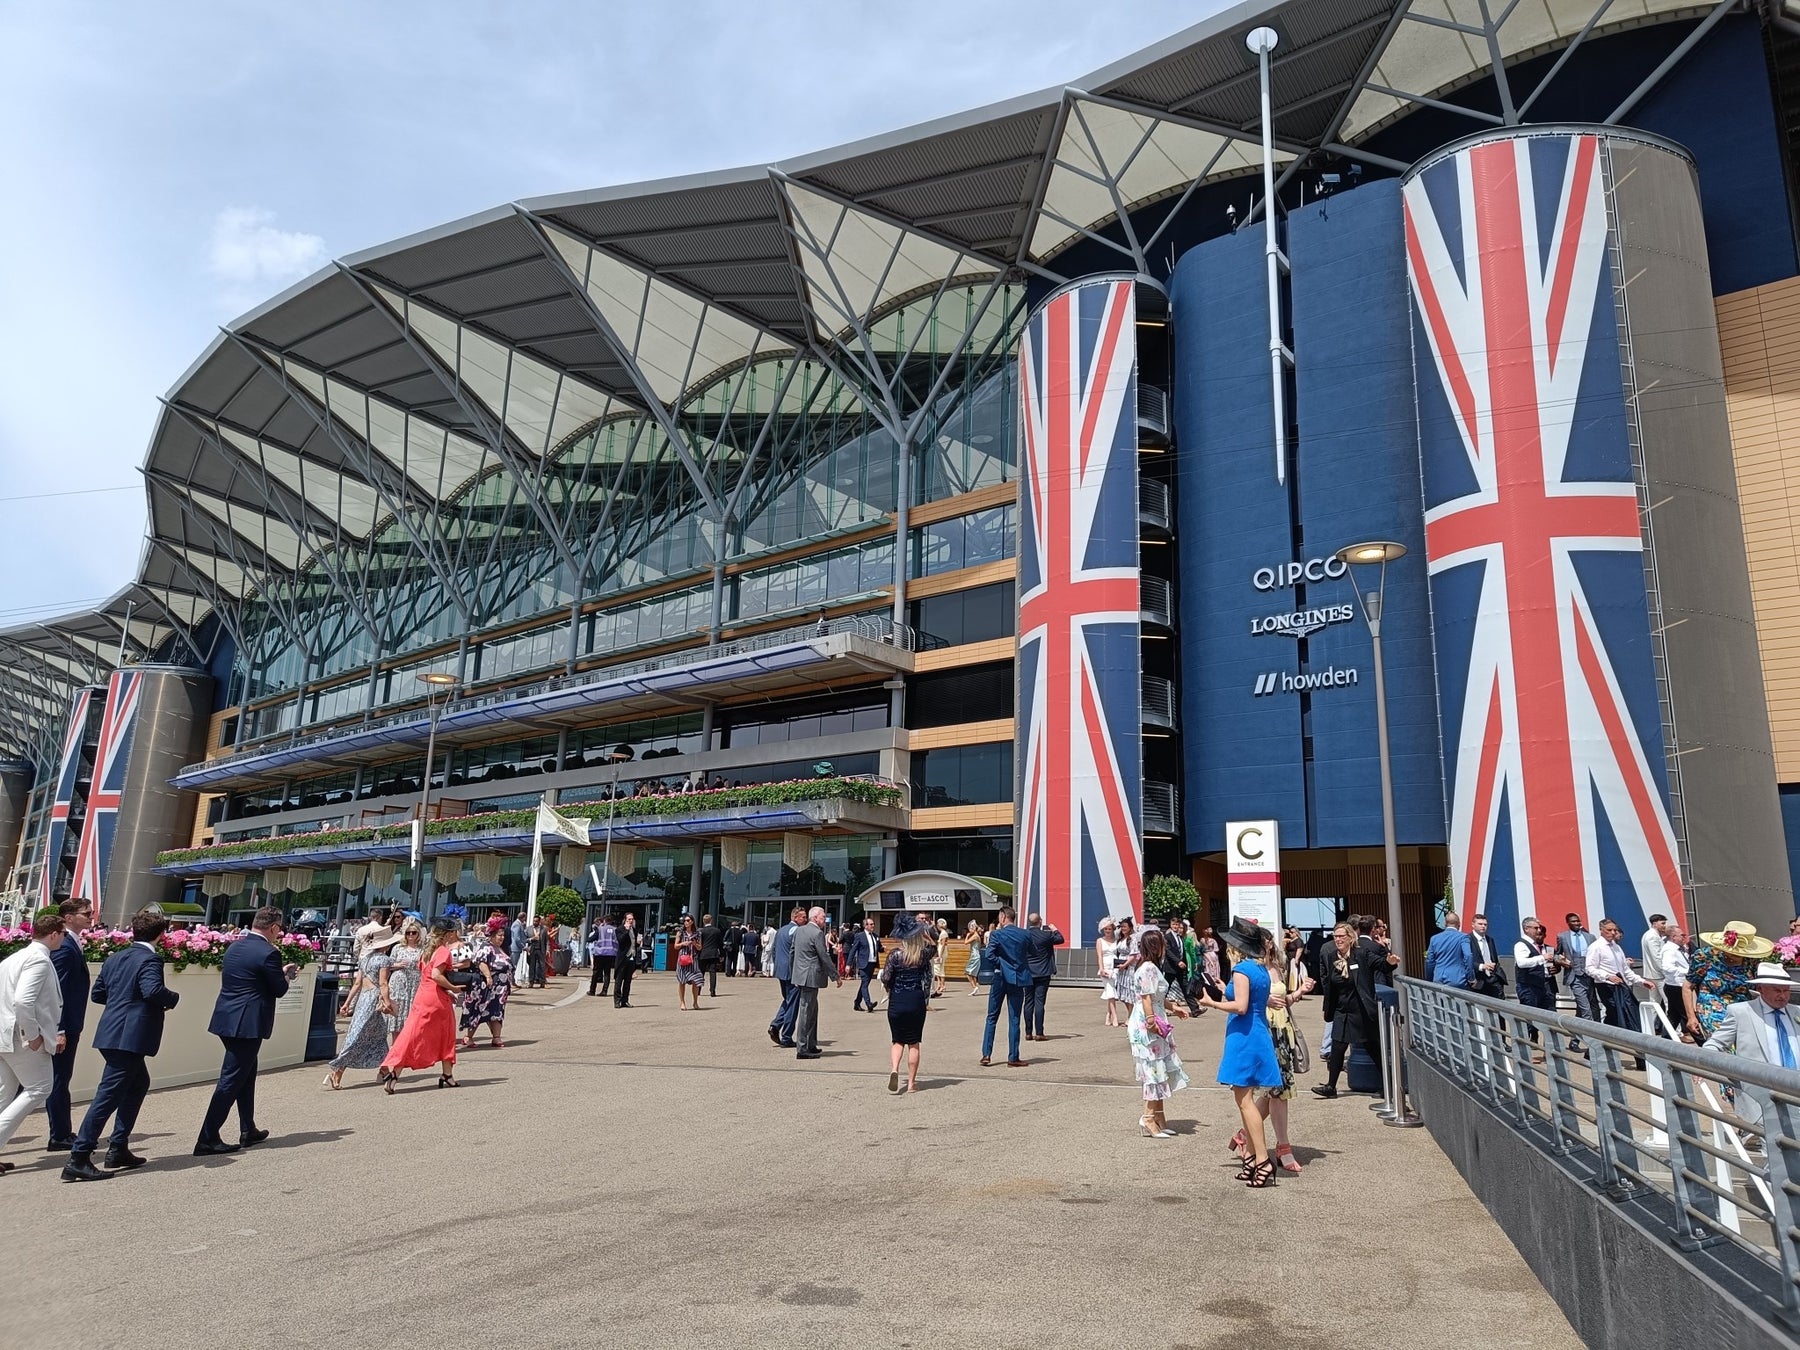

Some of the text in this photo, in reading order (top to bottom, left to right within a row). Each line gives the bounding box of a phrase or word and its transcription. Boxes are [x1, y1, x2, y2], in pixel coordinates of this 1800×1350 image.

[1253, 555, 1347, 591] QIPCO
[1251, 604, 1353, 633] LONGINES
[1282, 666, 1358, 691] howden
[1236, 828, 1264, 860] C
